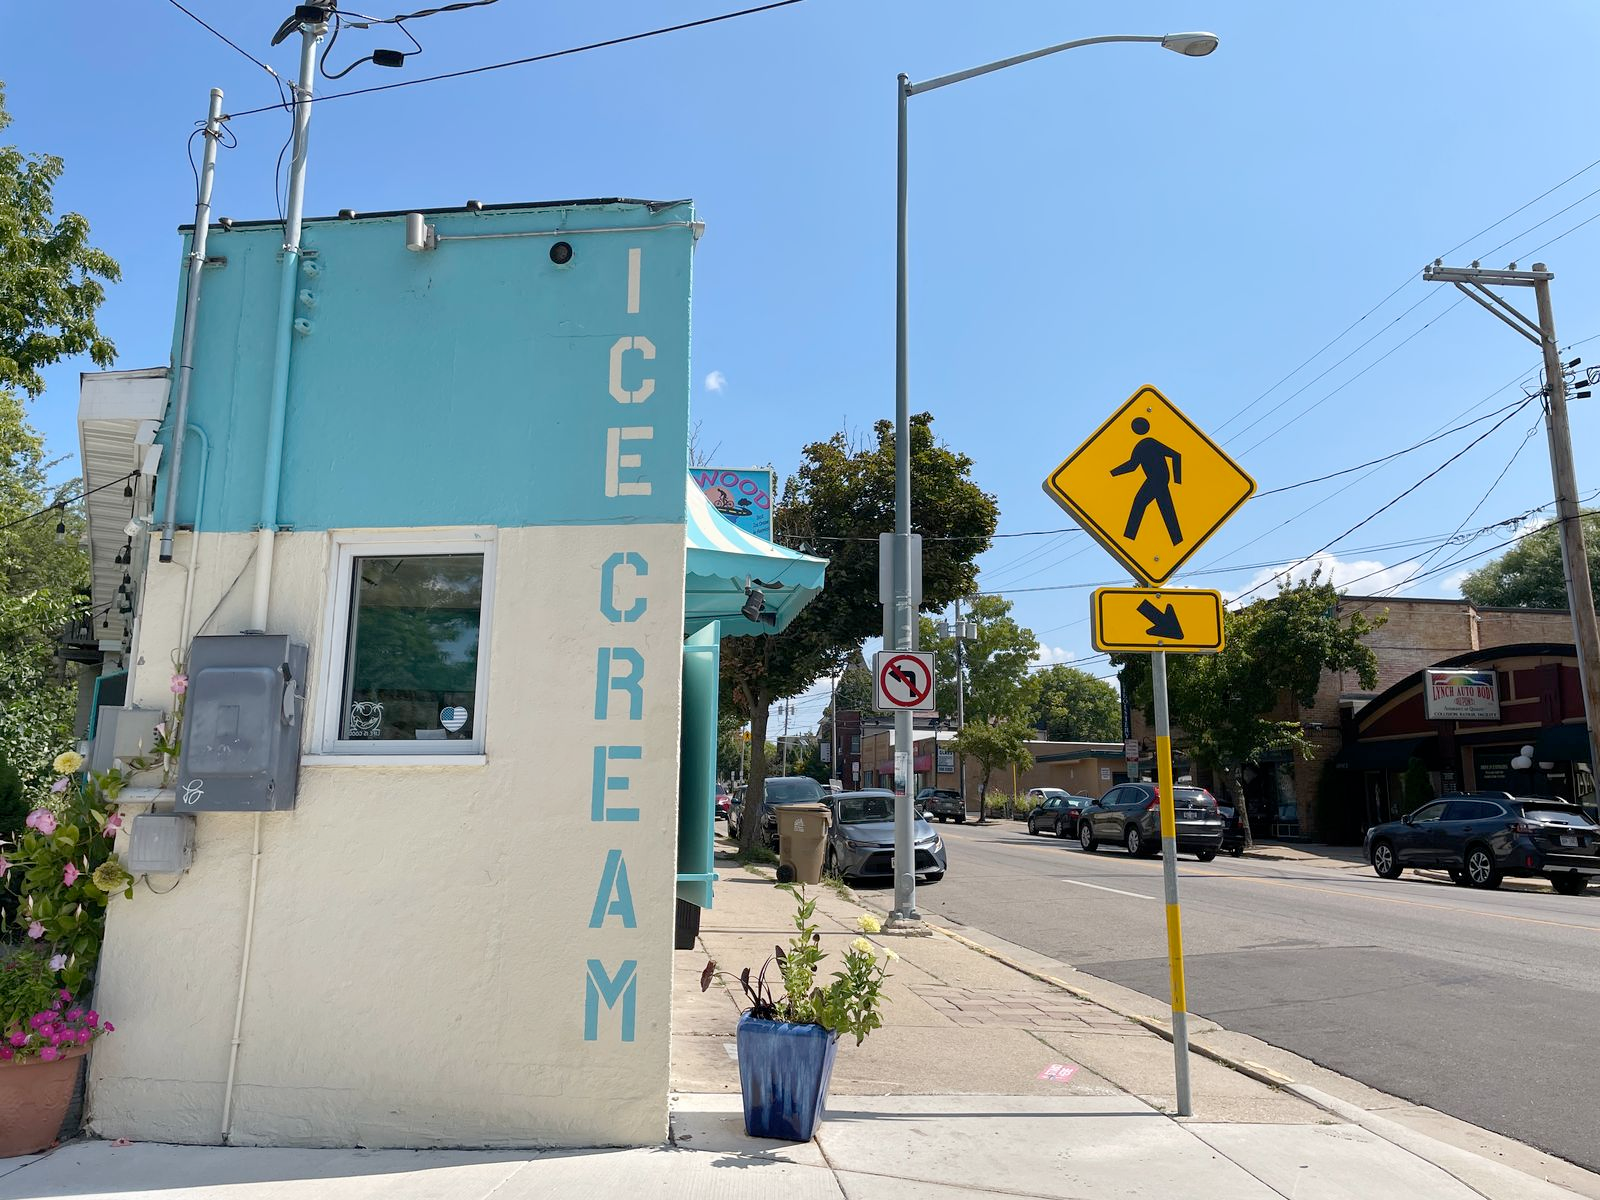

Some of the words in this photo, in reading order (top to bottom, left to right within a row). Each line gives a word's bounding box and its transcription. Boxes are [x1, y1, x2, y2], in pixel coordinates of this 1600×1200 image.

[605, 248, 656, 497] ICE
[584, 552, 648, 1041] CREAM
[1432, 686, 1454, 701] LYNCH
[1456, 686, 1474, 697] AUTO
[1477, 686, 1494, 702] BODY
